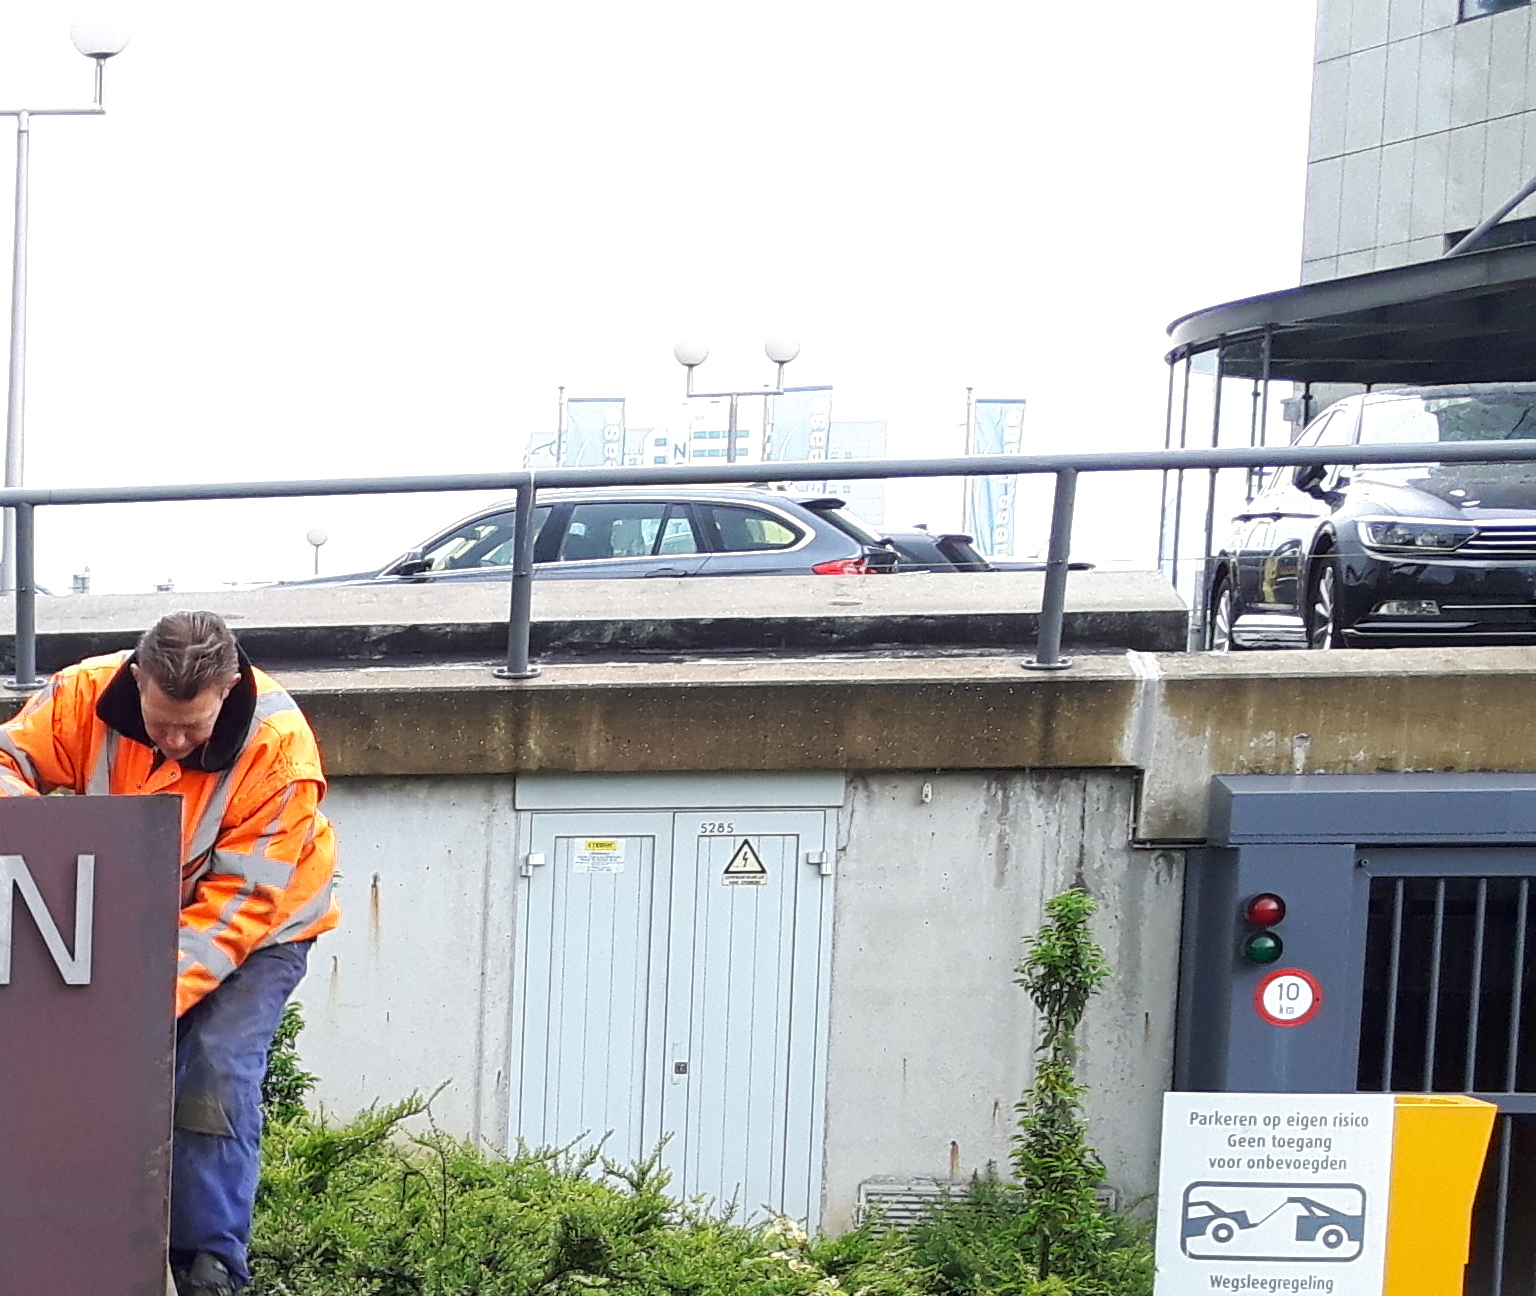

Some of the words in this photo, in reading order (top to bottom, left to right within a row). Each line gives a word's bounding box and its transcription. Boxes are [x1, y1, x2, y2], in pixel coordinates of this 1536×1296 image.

[700, 822, 734, 834] 5285
[1277, 982, 1300, 1001] 10
[1189, 1111, 1257, 1127] Parkeren
[1263, 1115, 1281, 1130] op
[1286, 1112, 1328, 1131] eigen
[1333, 1113, 1369, 1128] risico
[1227, 1134, 1266, 1148] Geen
[1271, 1135, 1332, 1152] toegang
[1208, 1157, 1242, 1169] voor
[1247, 1155, 1347, 1174] onbevoegden
[1209, 1274, 1334, 1294] Wegsleegregeling
